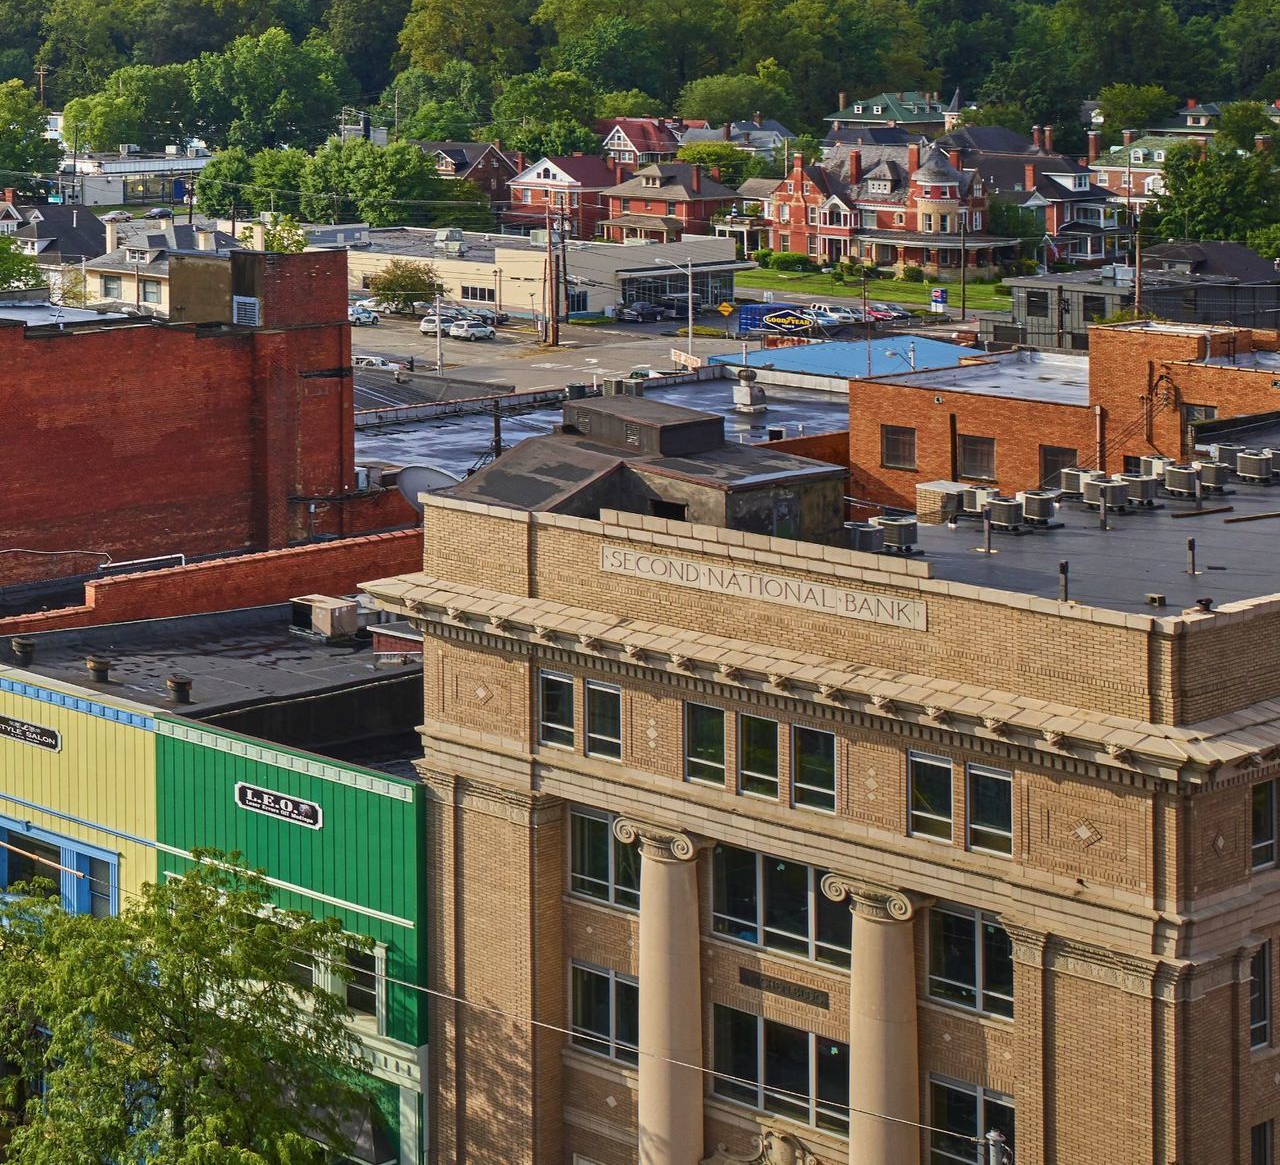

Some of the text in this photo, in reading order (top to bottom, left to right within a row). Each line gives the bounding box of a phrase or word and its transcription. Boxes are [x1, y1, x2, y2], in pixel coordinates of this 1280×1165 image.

[765, 316, 810, 325] GOODYEAR
[610, 551, 912, 623] SECOND NATIONAL BANK
[25, 731, 55, 745] SALON
[245, 788, 299, 813] L.E.O.
